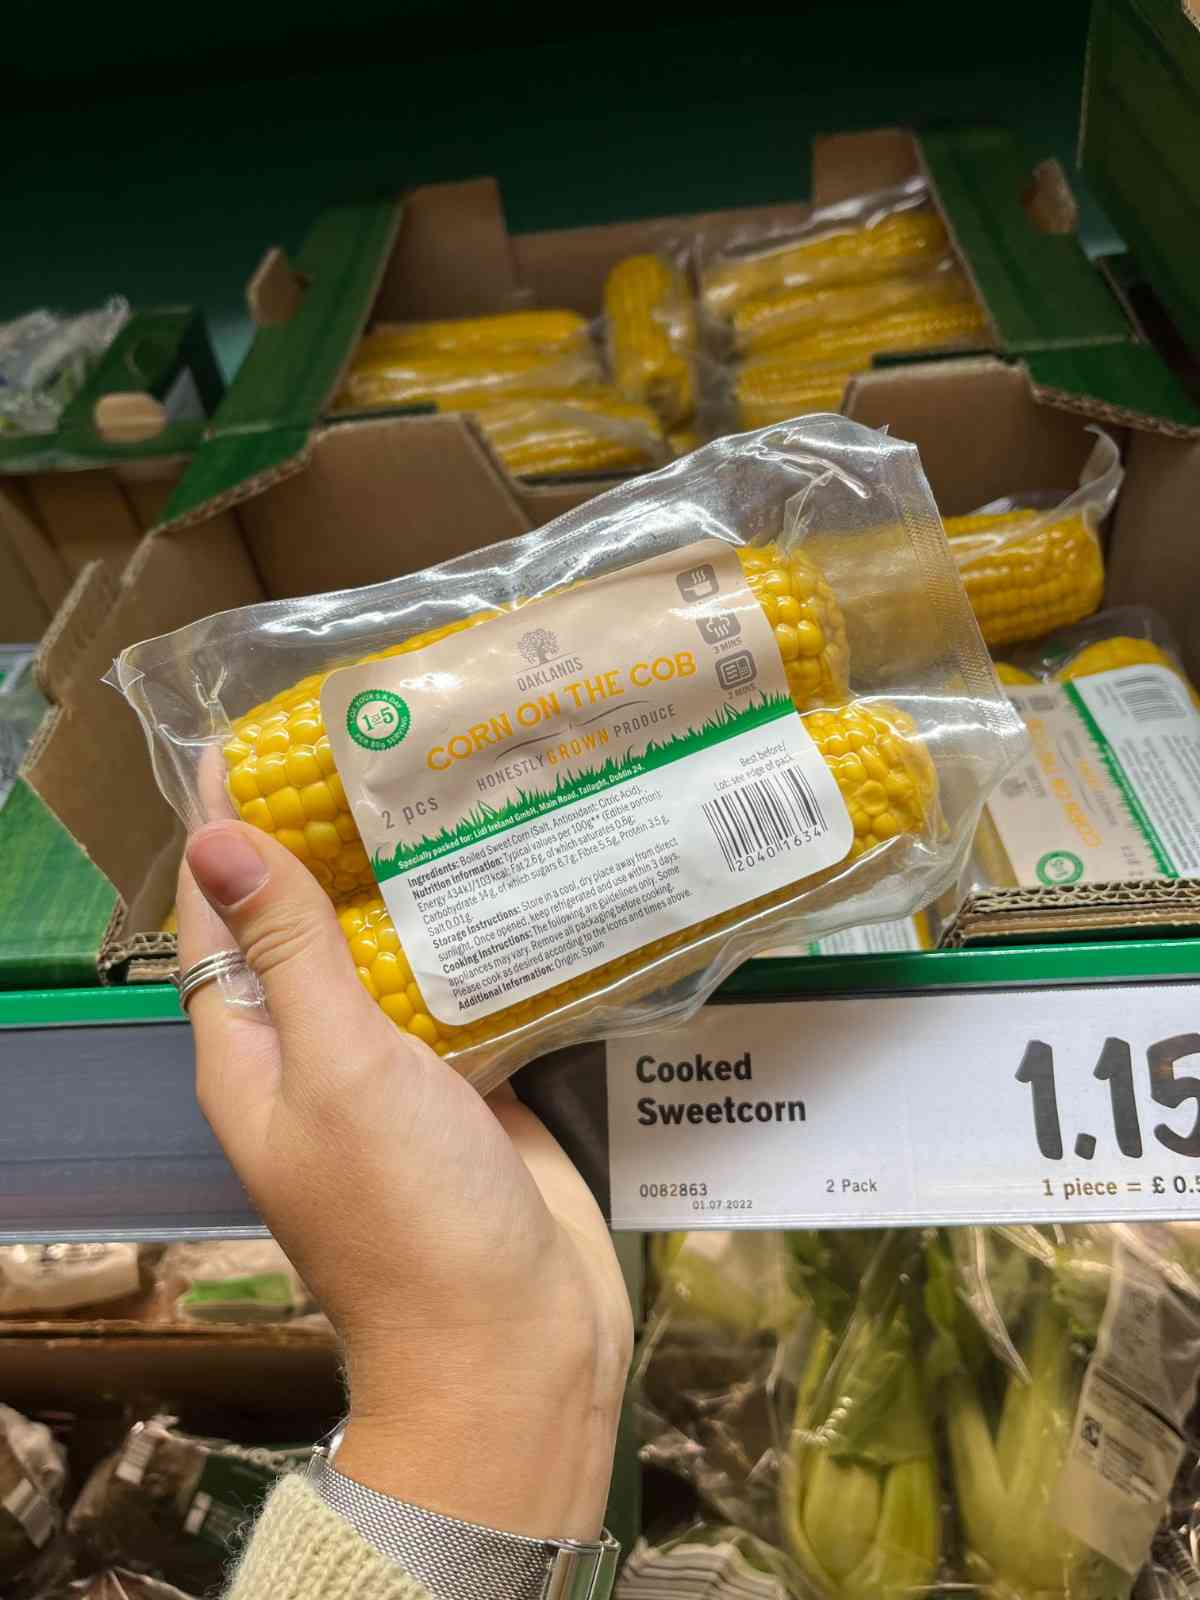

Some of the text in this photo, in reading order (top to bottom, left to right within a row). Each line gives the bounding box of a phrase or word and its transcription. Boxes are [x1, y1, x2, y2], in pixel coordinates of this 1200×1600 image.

[419, 642, 699, 775] CORN ON THE COB
[516, 653, 584, 694] OAKLANDS
[476, 701, 677, 792] HONESTLY GROWN PRODUCE
[380, 795, 440, 829] 2 pcs
[397, 848, 432, 870] Specially
[431, 837, 460, 857] packed
[487, 815, 514, 832] Ireland
[538, 797, 557, 811] Main
[608, 766, 632, 782] Dublin
[406, 858, 460, 889] Ingredients:
[458, 846, 486, 866] Boiled
[484, 836, 512, 855] Sweet
[510, 828, 531, 845] Corn
[597, 791, 620, 808] Citric
[734, 826, 822, 872] 2040 1634
[411, 876, 452, 900] Nutrition
[502, 843, 532, 864] Typical
[529, 832, 557, 851] values
[556, 828, 572, 841] per
[416, 892, 447, 914] Energy
[509, 859, 525, 873] Fat
[553, 836, 578, 855] which
[576, 821, 615, 845] saturates
[421, 893, 479, 925] Carbohydrate
[505, 871, 531, 889] which
[529, 860, 558, 880] sugars
[576, 842, 598, 858] Fibre
[618, 821, 649, 842] Protein
[430, 926, 467, 951] Storage
[465, 903, 521, 935] Instructions:
[520, 894, 544, 911] Store
[590, 863, 616, 882] place
[613, 856, 635, 872] away
[633, 845, 656, 862] from
[652, 835, 679, 854] direct
[426, 921, 446, 937] Salt
[441, 951, 480, 976] Cooking
[477, 927, 534, 960] Instructions:
[531, 921, 549, 936] The
[546, 905, 586, 931] following
[583, 901, 599, 914] are
[596, 882, 640, 910] guidelines
[655, 863, 680, 881] Some
[446, 960, 494, 988] appliances
[492, 953, 512, 969] may
[530, 929, 565, 952] Remove
[573, 906, 617, 934] packaging
[614, 894, 642, 914] before
[471, 928, 496, 947] Once
[528, 905, 551, 924] keep
[548, 885, 598, 915] refrigerated
[595, 879, 612, 894] and
[611, 873, 628, 886] use
[626, 861, 652, 880] within
[451, 979, 482, 999] Please
[480, 970, 501, 987] cook
[501, 966, 513, 978] as
[511, 951, 544, 973] desired
[541, 933, 586, 961] according
[591, 923, 608, 938] the
[626, 907, 644, 922] and
[642, 897, 667, 915] times
[456, 984, 503, 1011] Additional
[636, 1052, 753, 1084] Cooked
[1015, 1032, 1200, 1161] 1.15
[637, 1097, 807, 1126] Sweetcorn
[639, 1182, 708, 1198] 0082863
[692, 1199, 753, 1210] 01.07.2022
[825, 1178, 878, 1193] 2 Pack
[1042, 1179, 1053, 1196] 1
[1063, 1176, 1118, 1199] piece
[1152, 1176, 1165, 1194] £
